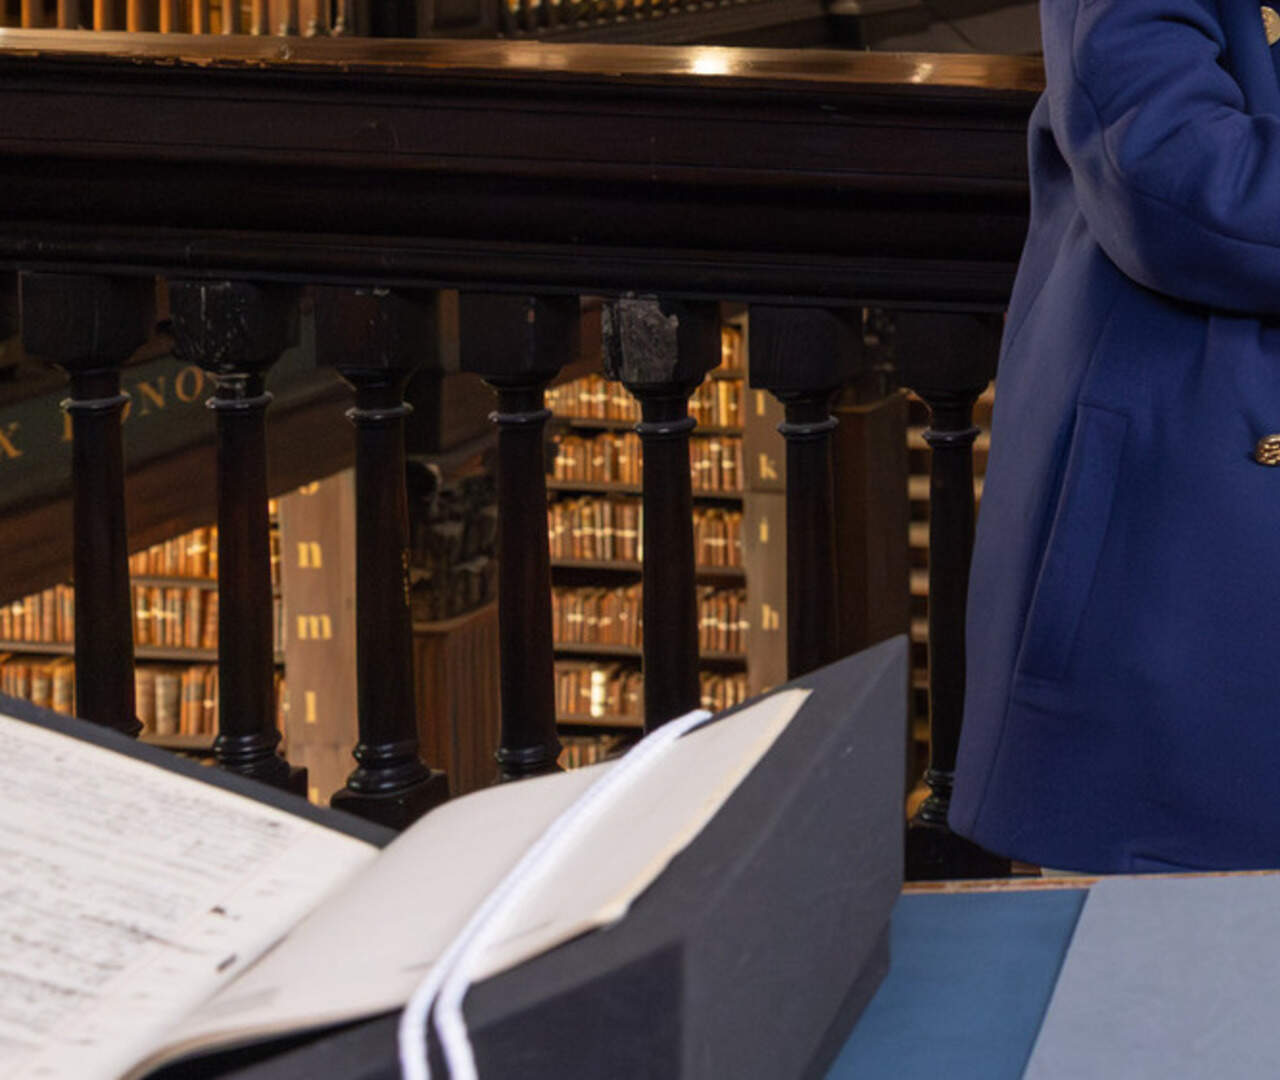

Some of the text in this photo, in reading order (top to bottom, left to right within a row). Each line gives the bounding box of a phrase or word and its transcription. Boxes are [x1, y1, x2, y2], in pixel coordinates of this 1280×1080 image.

[61, 366, 204, 442] NO
[758, 453, 778, 480] k
[297, 541, 322, 569] n
[297, 615, 332, 640] m
[761, 604, 780, 631] h
